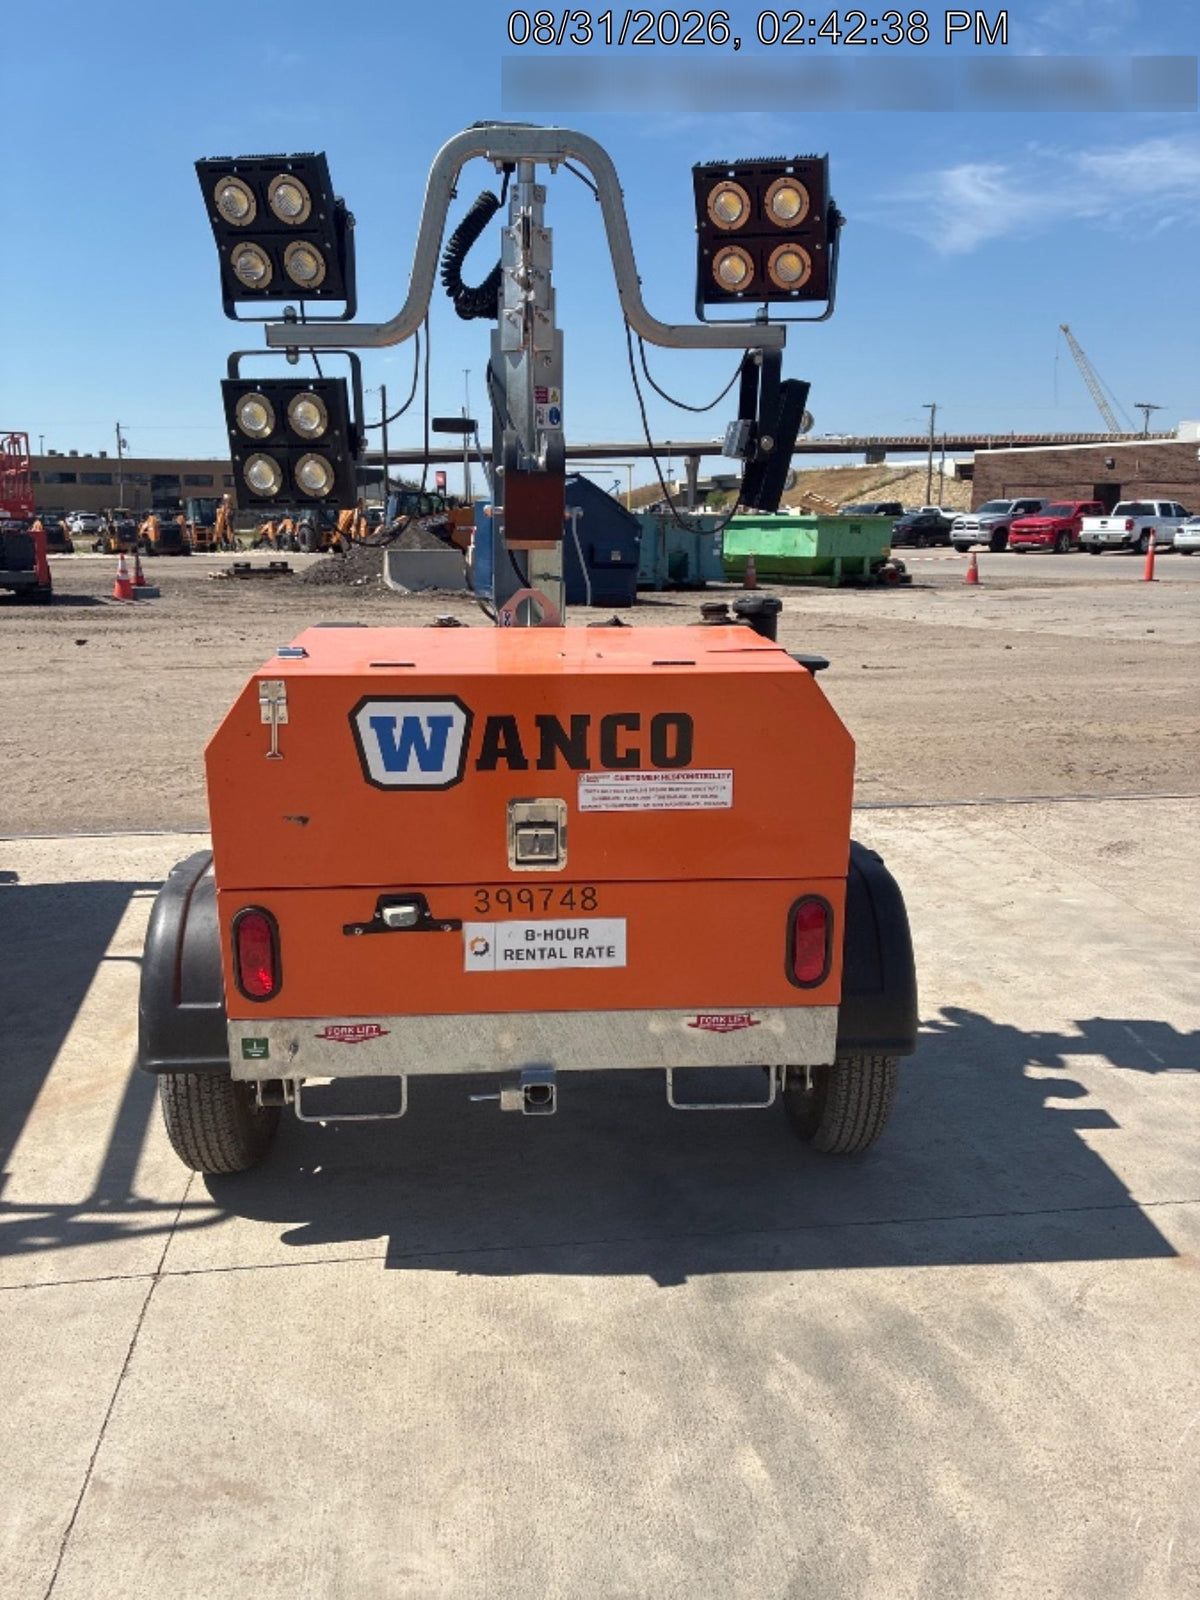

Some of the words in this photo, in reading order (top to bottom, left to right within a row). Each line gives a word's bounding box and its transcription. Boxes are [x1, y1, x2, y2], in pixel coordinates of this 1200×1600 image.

[369, 712, 694, 772] WANCO
[474, 886, 598, 913] 399748
[504, 948, 567, 961] RENTAL
[573, 945, 616, 959] RATE
